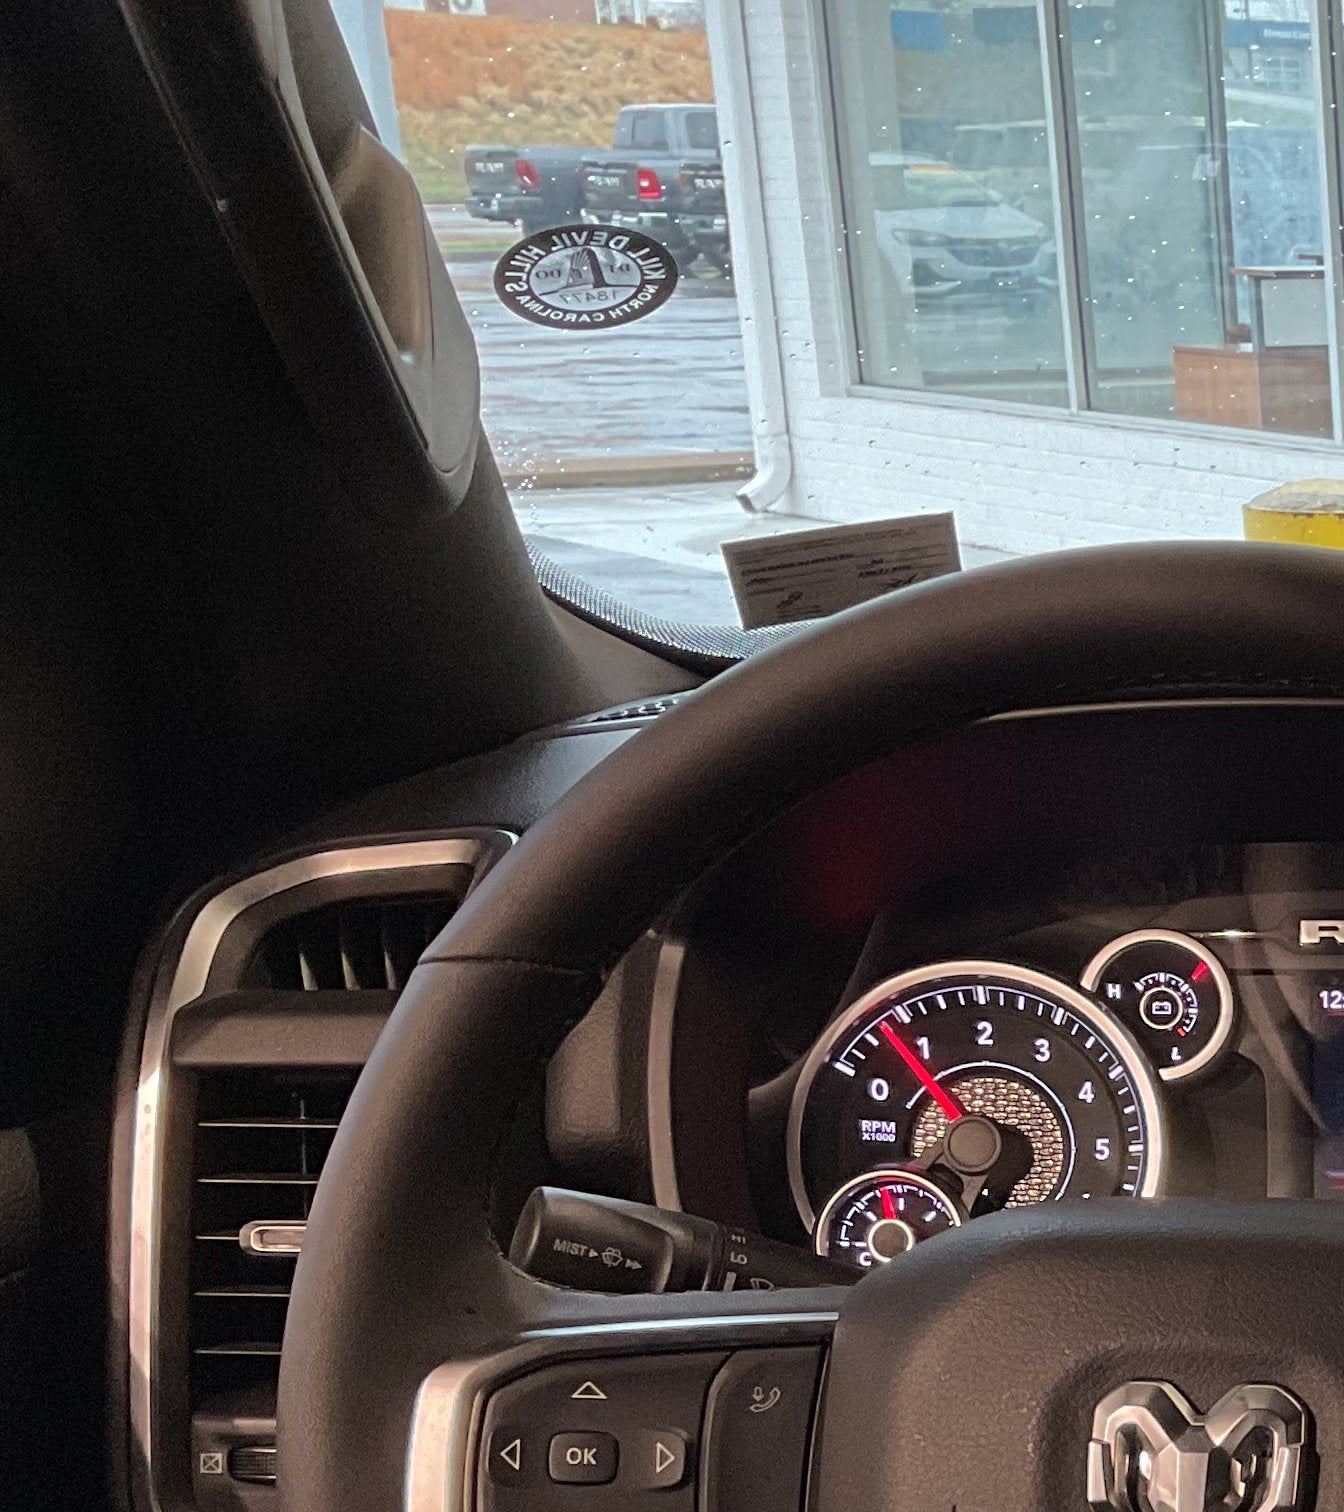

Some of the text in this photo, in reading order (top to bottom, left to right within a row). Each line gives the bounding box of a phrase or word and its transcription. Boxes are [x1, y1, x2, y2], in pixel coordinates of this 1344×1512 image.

[1107, 983, 1121, 999] H
[976, 1021, 994, 1045] 2
[916, 1037, 930, 1059] 1
[1034, 1038, 1050, 1062] 3
[1171, 1046, 1181, 1060] L
[871, 1084, 889, 1101] 0
[1078, 1081, 1095, 1103] 4
[861, 1120, 896, 1133] RPM
[862, 1132, 896, 1142] X1000
[1095, 1138, 1110, 1160] 5
[553, 1238, 589, 1258] MIST
[859, 1251, 872, 1266] C
[566, 1447, 597, 1465] OK
